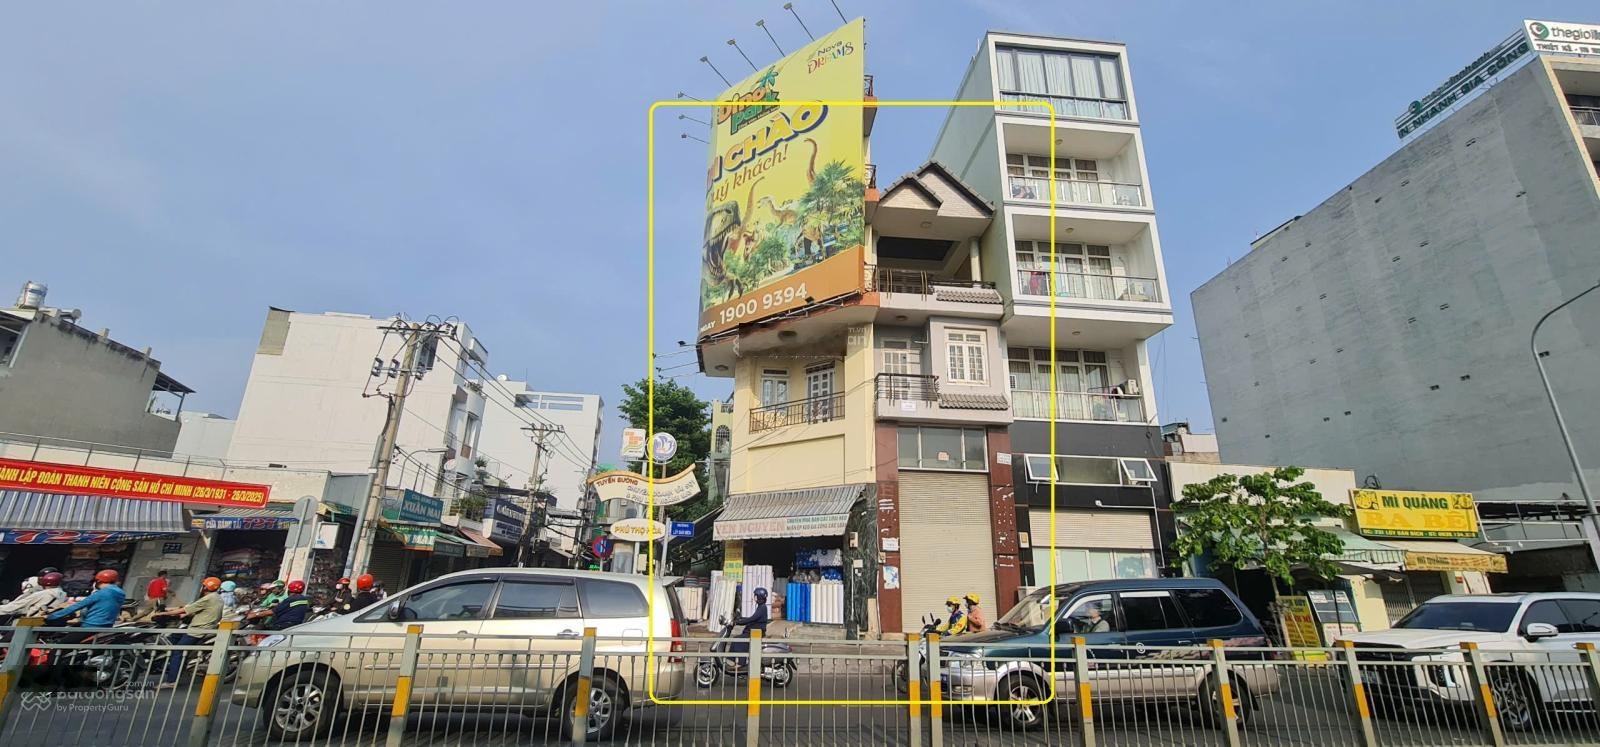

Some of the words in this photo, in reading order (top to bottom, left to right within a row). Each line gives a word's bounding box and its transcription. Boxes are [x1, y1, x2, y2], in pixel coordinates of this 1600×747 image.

[717, 86, 766, 124] Dino
[723, 100, 828, 171] CHÀO
[733, 143, 789, 190] khách!
[719, 298, 758, 325] 1900
[762, 282, 808, 310] 9394
[62, 474, 90, 488] THANH
[173, 484, 193, 496] MINH
[1381, 493, 1399, 508] MÌ
[1402, 493, 1449, 510] QUẢNG
[242, 517, 276, 529] 727
[1362, 511, 1414, 528] BA
[10, 529, 114, 544] 727
